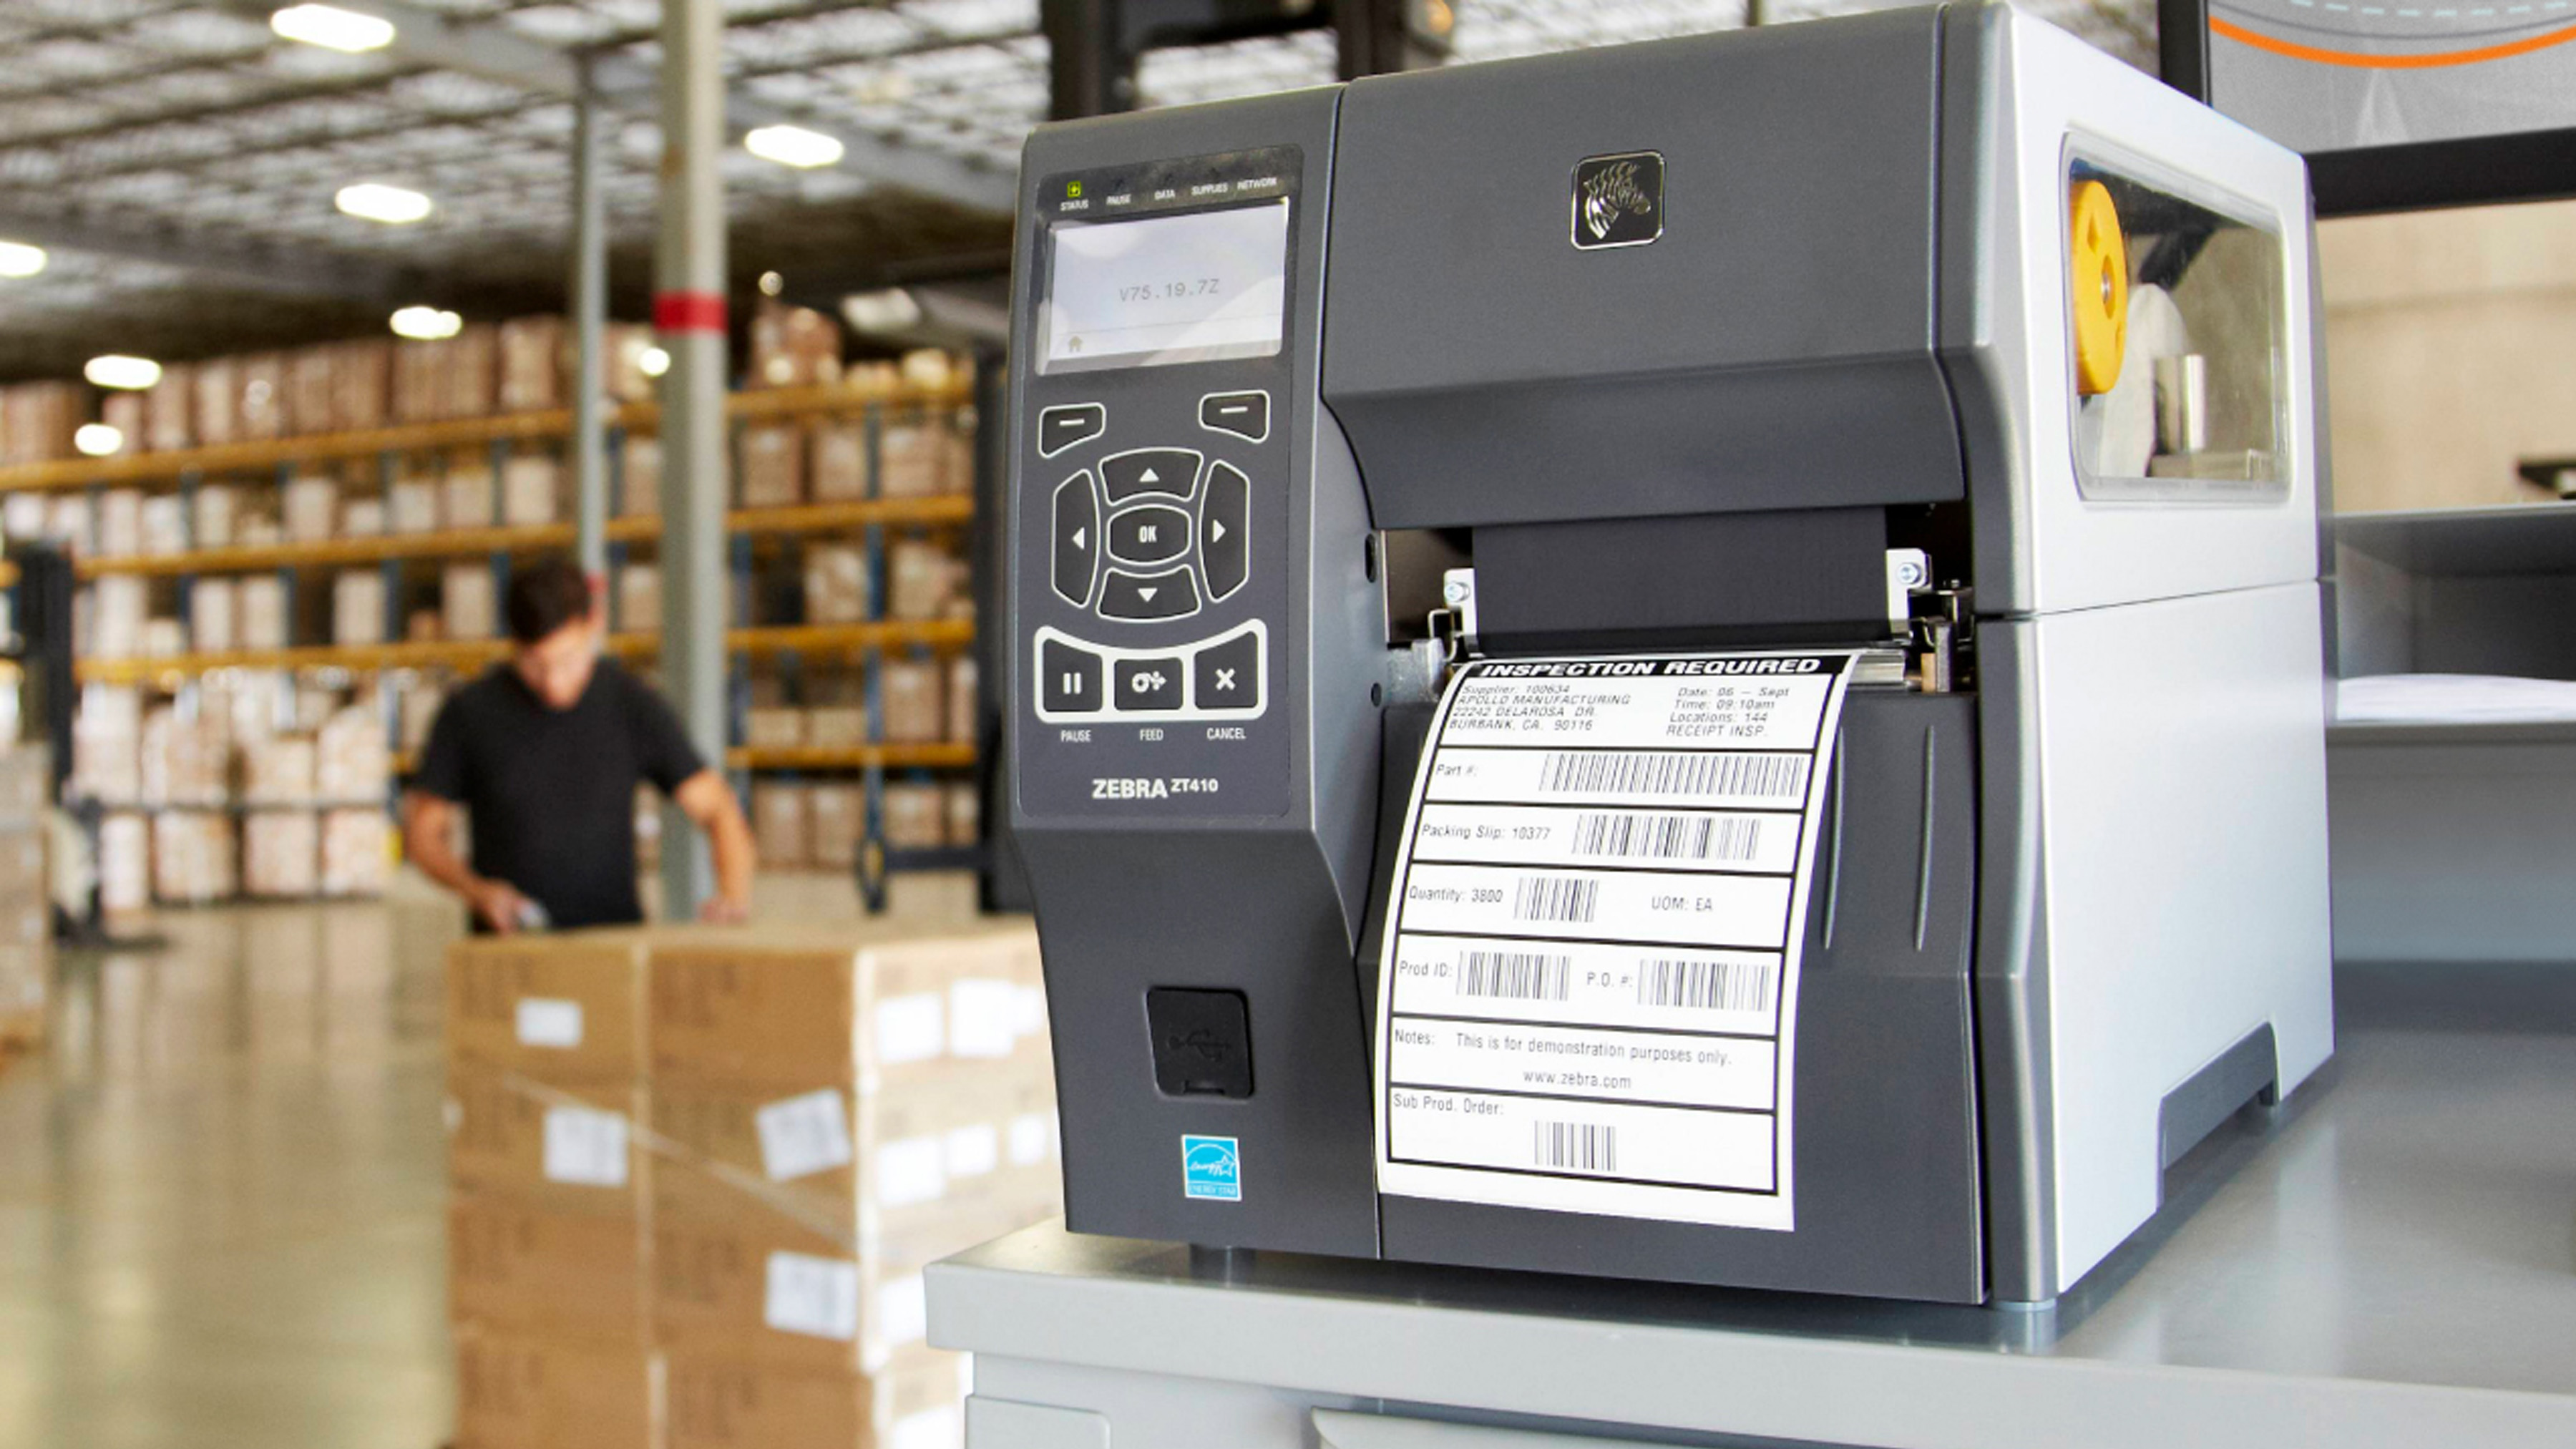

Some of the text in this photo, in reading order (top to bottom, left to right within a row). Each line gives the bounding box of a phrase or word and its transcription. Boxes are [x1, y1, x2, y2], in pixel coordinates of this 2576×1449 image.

[1060, 177, 1277, 211] STATUS PAUSE DATA SUPPLIES NETWORK
[1138, 525, 1157, 543] OK
[1479, 659, 1821, 677] INSPECTION REQUIRED
[1462, 685, 1570, 695] Supplier: 100634
[1678, 688, 1712, 697] Date:
[1717, 688, 1734, 696] 06
[1759, 688, 1790, 698] Sept
[1458, 695, 1631, 705] APOLLO MANUFACTURING
[1674, 699, 1775, 710] Time: 09:10am
[1453, 707, 1491, 717] 22242
[1495, 707, 1565, 717] DELAROSA
[1669, 712, 1767, 723] Locations: 144
[1553, 720, 1594, 731] 90116
[1667, 725, 1767, 737] RECEIPT INSP.
[1060, 727, 1246, 743] PAUSE FEED CANCEL
[1435, 763, 1463, 776] Part
[1091, 778, 1219, 799] ZEBRA ZT410
[1422, 824, 1551, 841] Packing Slip: 10377
[1409, 885, 1503, 903] Quantity: 3800
[1652, 896, 1713, 912] UOM: EA
[1399, 960, 1453, 977] Prod ID:
[1586, 972, 1614, 987] P.O.
[1395, 1029, 1435, 1045] Notes:
[1456, 1033, 1732, 1067] This is for demonstration purposes only.
[1523, 1071, 1632, 1089] www.zebra.com
[1393, 1093, 1504, 1115] Sub Prod. Order:
